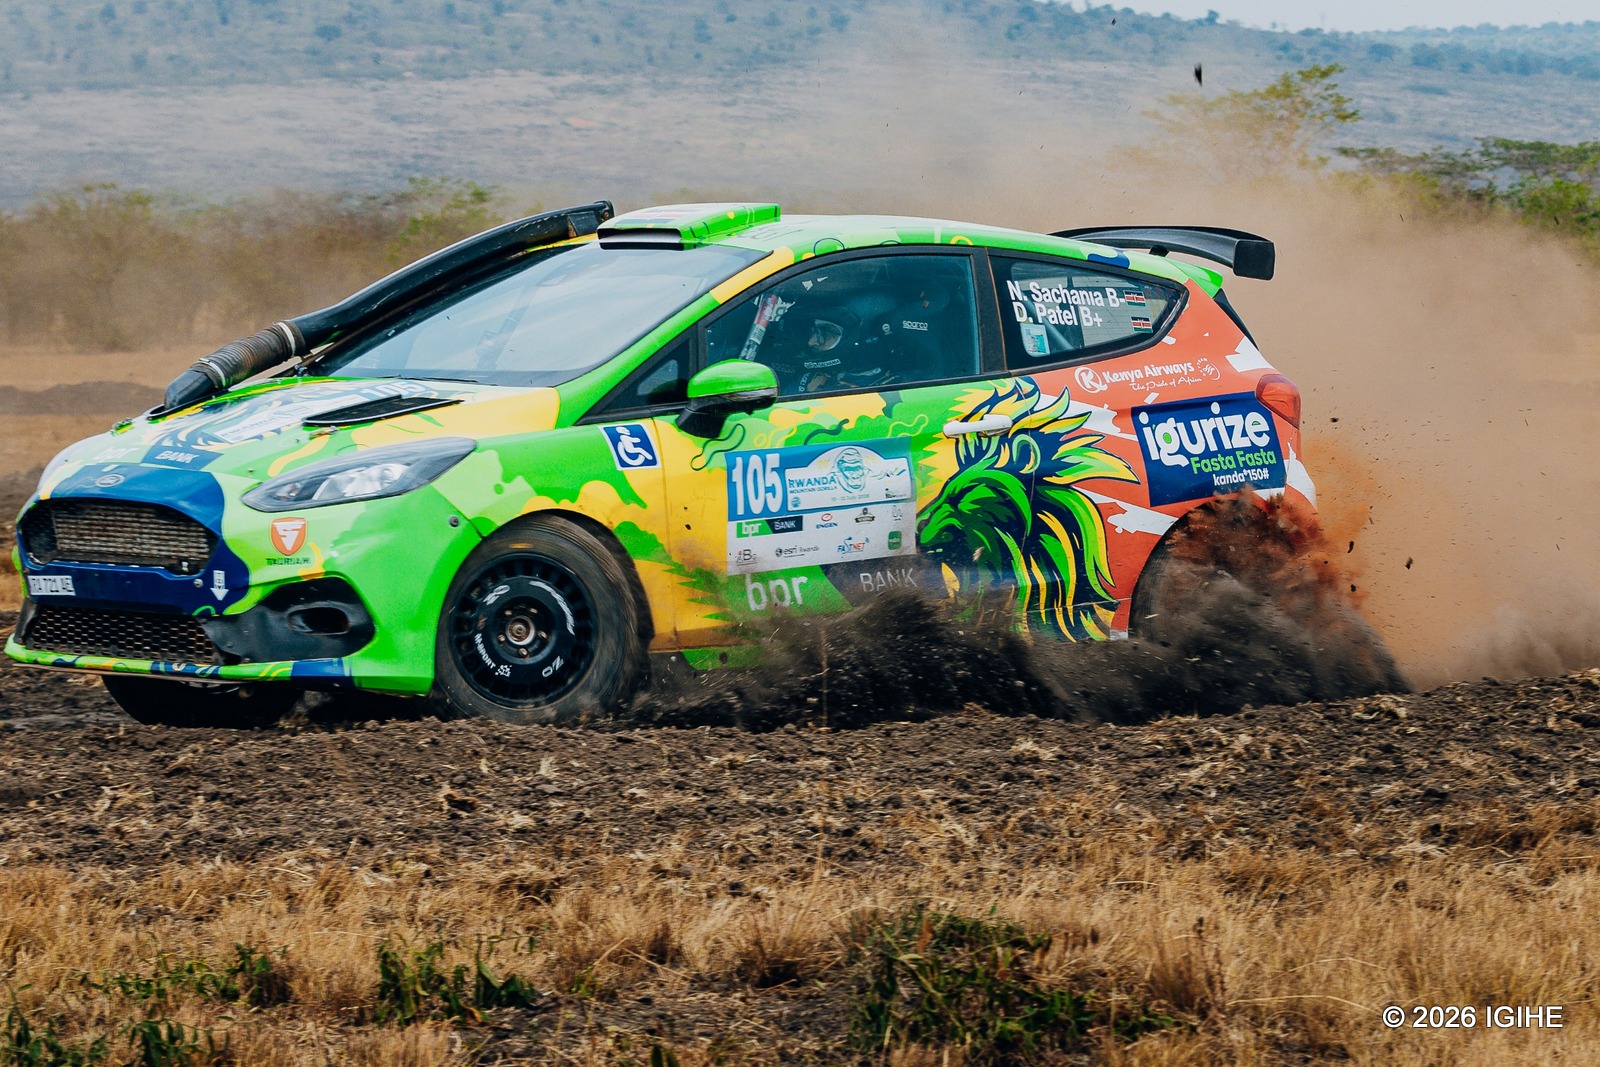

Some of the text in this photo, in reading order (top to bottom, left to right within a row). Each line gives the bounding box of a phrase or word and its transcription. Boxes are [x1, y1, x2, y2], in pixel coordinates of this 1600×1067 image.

[1006, 280, 1028, 301] N.
[1029, 281, 1105, 307] Sachania
[902, 320, 928, 331] sparco
[1012, 301, 1103, 327] D. Patel B+
[1102, 369, 1143, 384] Kenya
[1143, 361, 1195, 378] Airways
[359, 381, 426, 397] 105
[1129, 381, 1146, 391] The
[1146, 378, 1169, 391] Pride
[1138, 401, 1270, 468] igurize
[155, 450, 199, 464] BANK
[1189, 448, 1277, 475] Fasta Fasta
[731, 453, 783, 515] 105
[788, 476, 837, 489] RWANDA
[789, 486, 816, 494] MOUNTAIN
[742, 521, 796, 537] bpr BANK
[746, 568, 918, 611] bpr BANK
[474, 632, 497, 670] M-SPORT
[541, 655, 565, 678] OZ
